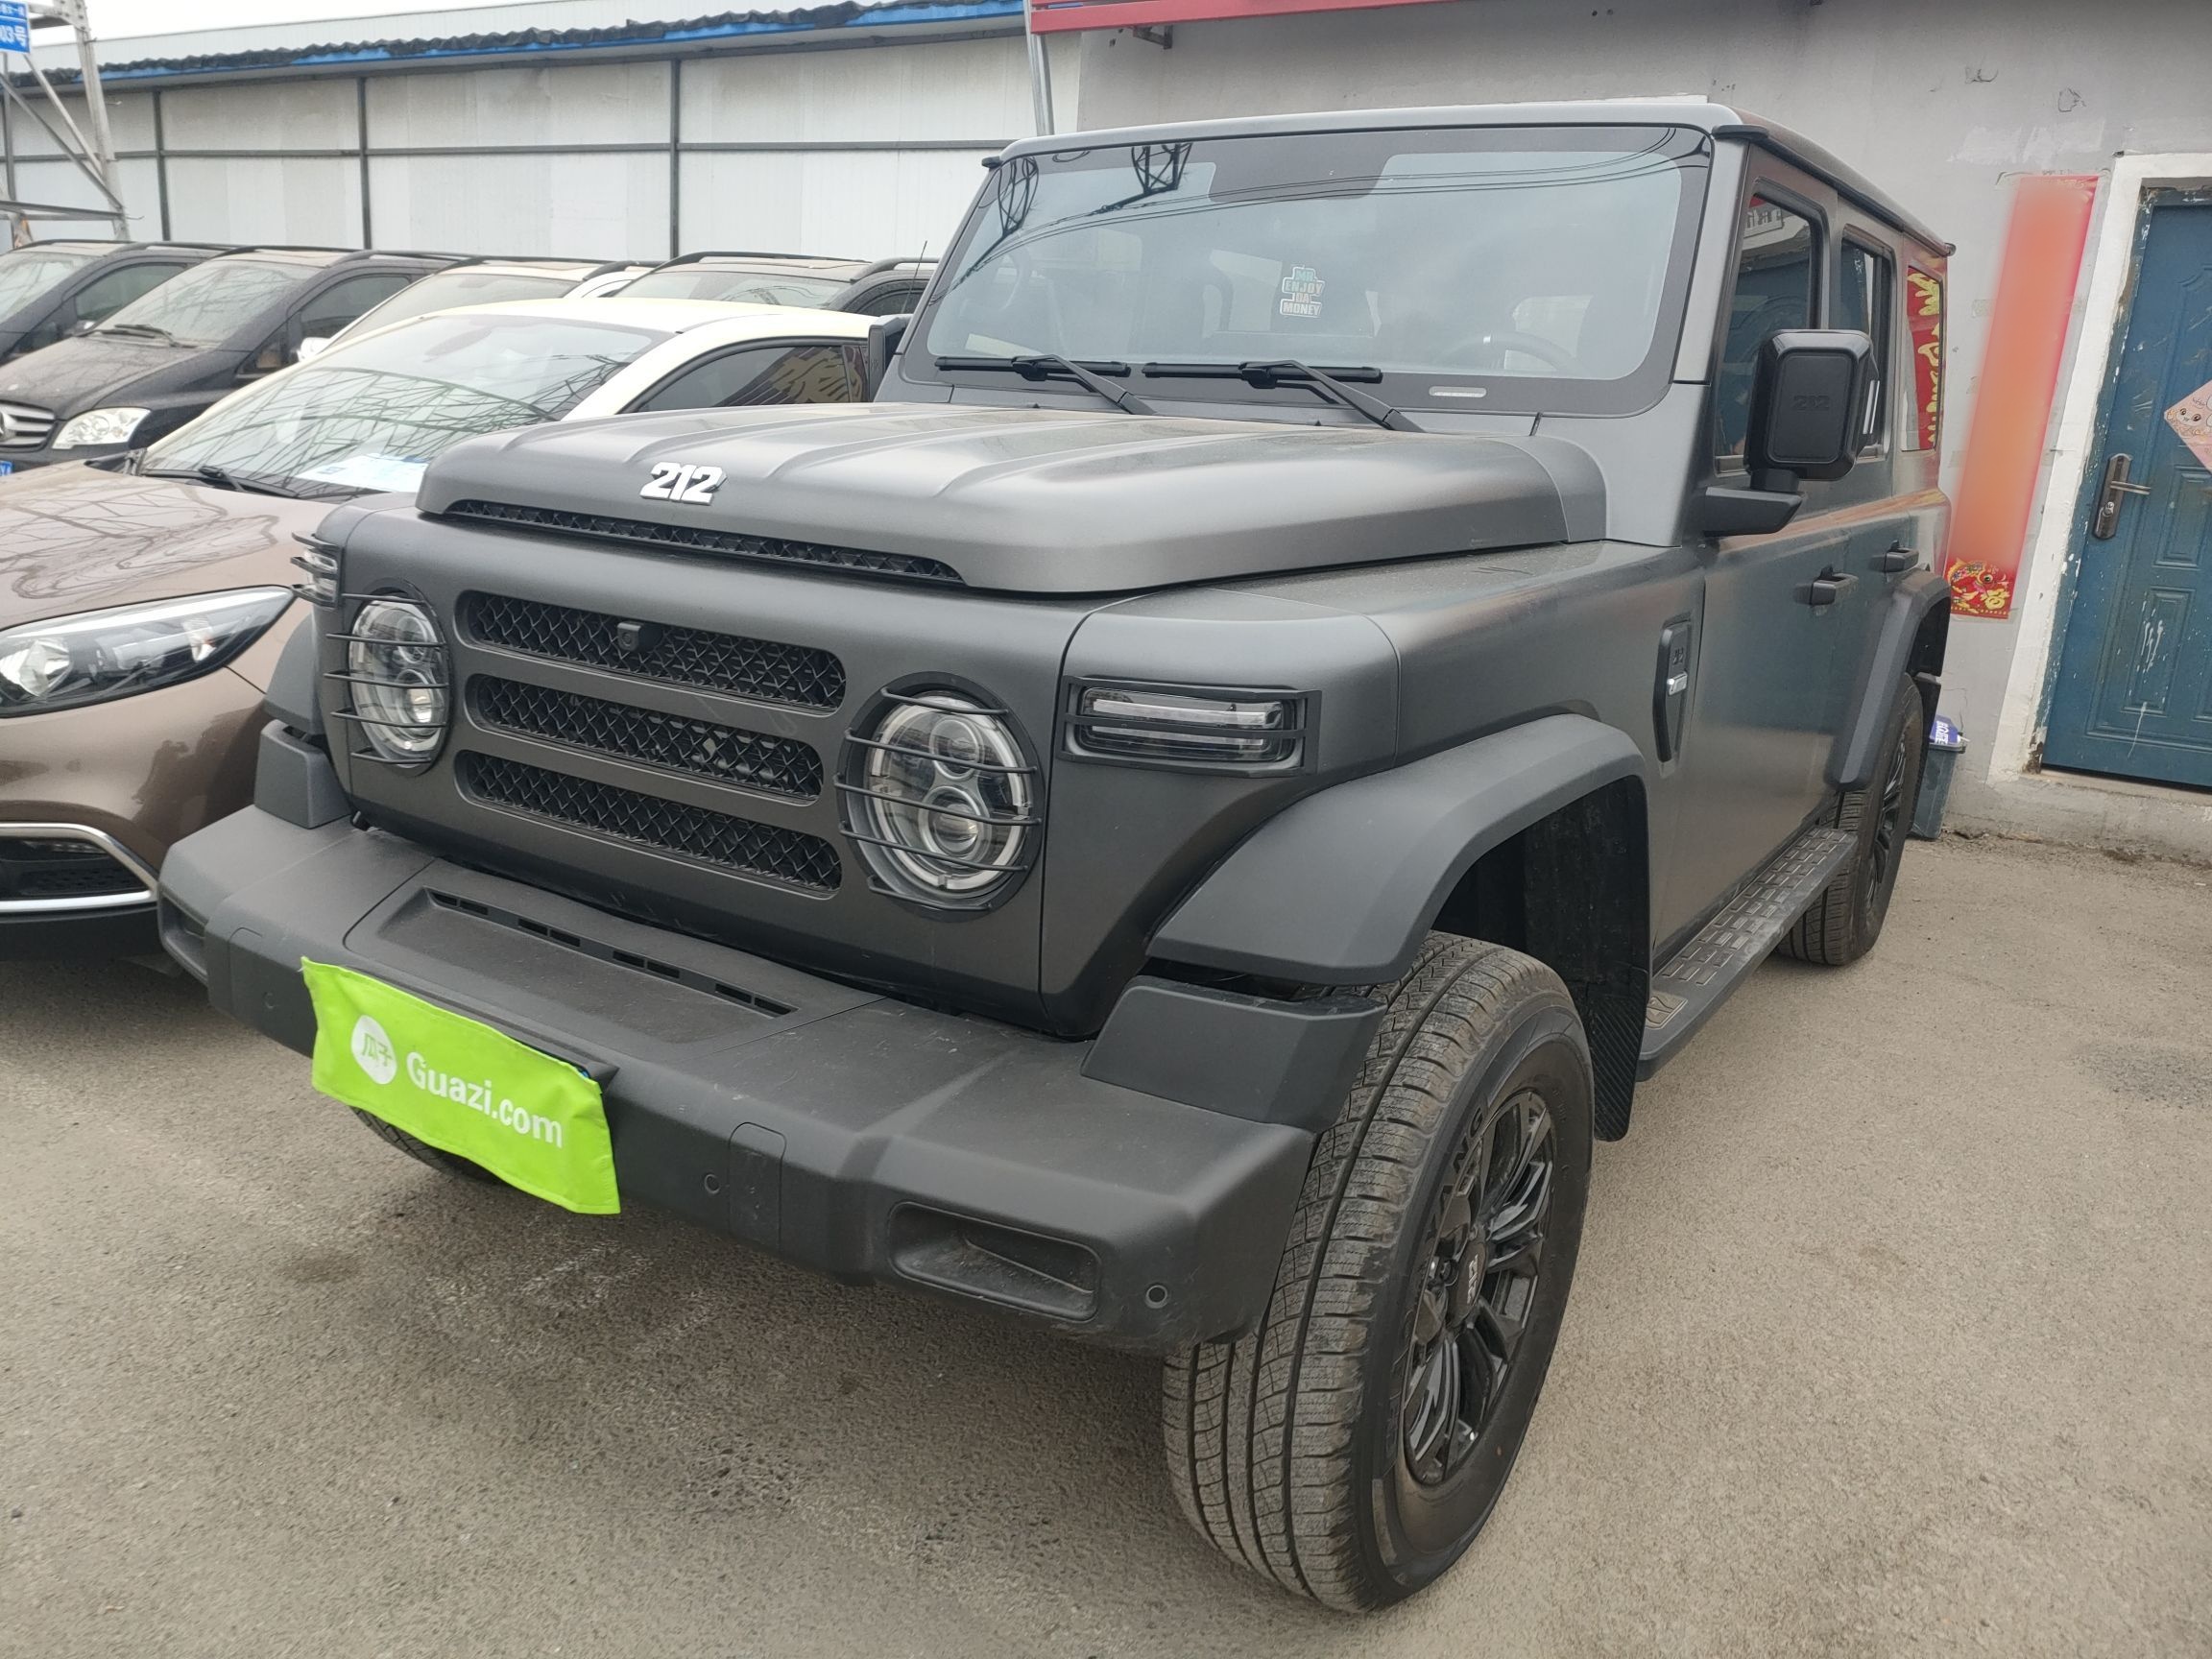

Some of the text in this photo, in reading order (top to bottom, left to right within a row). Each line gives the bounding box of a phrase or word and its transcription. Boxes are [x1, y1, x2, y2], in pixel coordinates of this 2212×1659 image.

[1285, 280, 1322, 294] ENJOY
[1295, 293, 1310, 303] DA
[1283, 301, 1321, 315] MONEY
[639, 462, 728, 506] 212
[362, 1033, 393, 1067] 瓜子
[406, 1051, 563, 1148] Guazi.com
